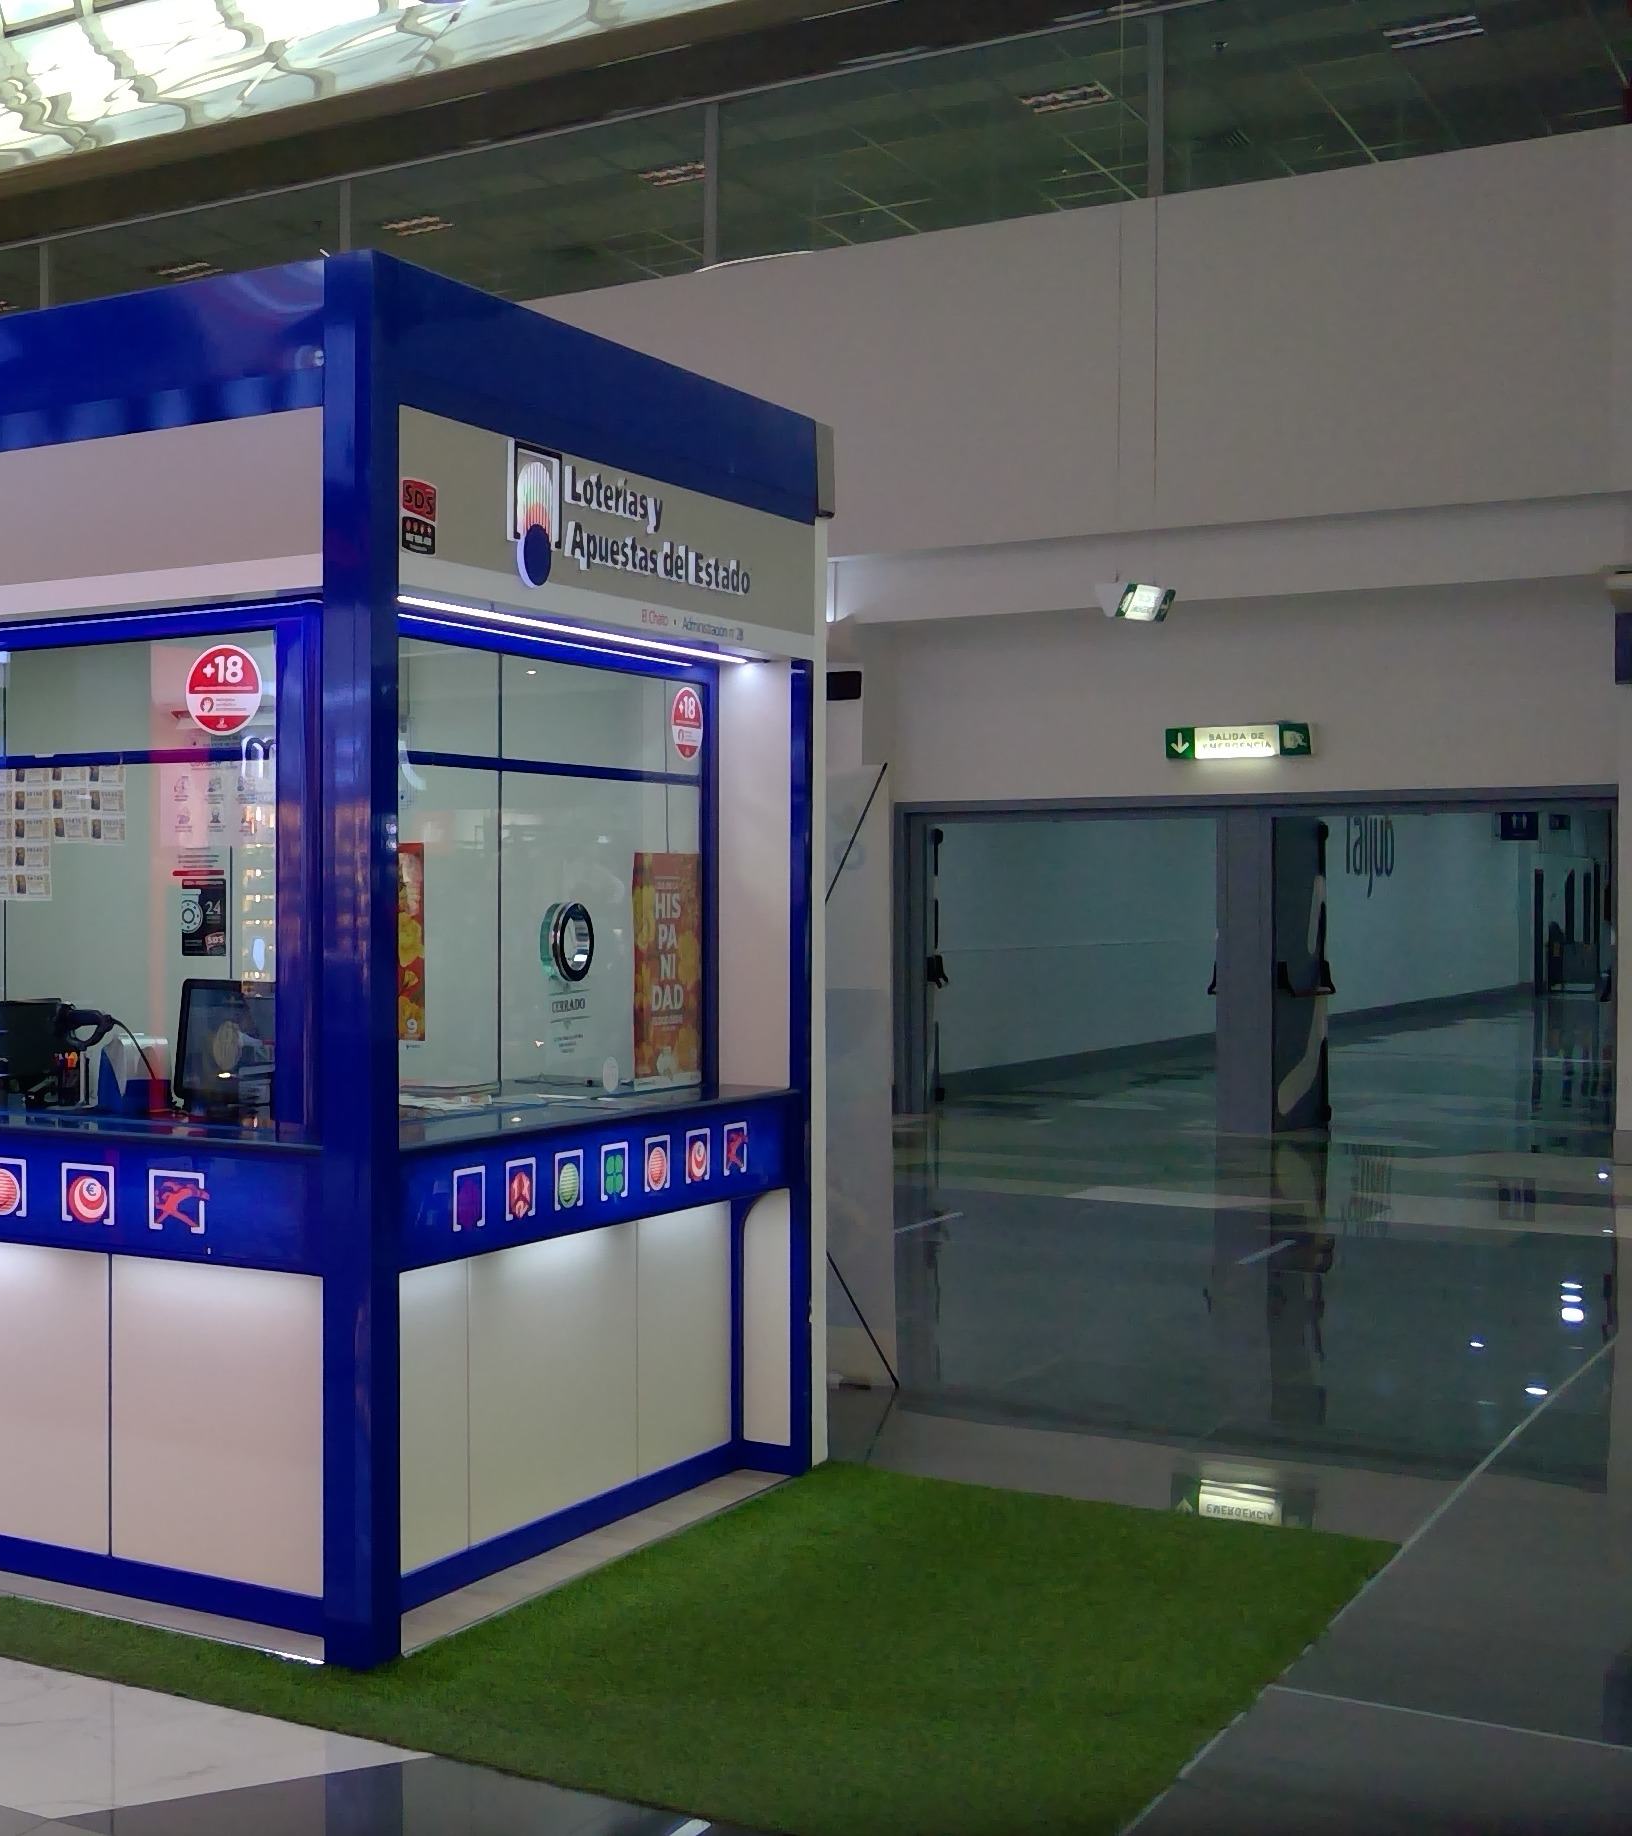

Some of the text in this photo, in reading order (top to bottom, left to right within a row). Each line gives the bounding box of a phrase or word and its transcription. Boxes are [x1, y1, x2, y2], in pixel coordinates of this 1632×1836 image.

[566, 465, 663, 533] Loterías y
[566, 521, 751, 595] Apuestas del Estado
[202, 654, 244, 684] +18
[678, 695, 696, 720] +18
[1208, 732, 1265, 741] SALIDA DE
[204, 900, 222, 916] 24
[654, 892, 682, 920] HIS
[658, 923, 679, 950] PA
[660, 952, 677, 981] NI
[651, 984, 684, 1012] DAD
